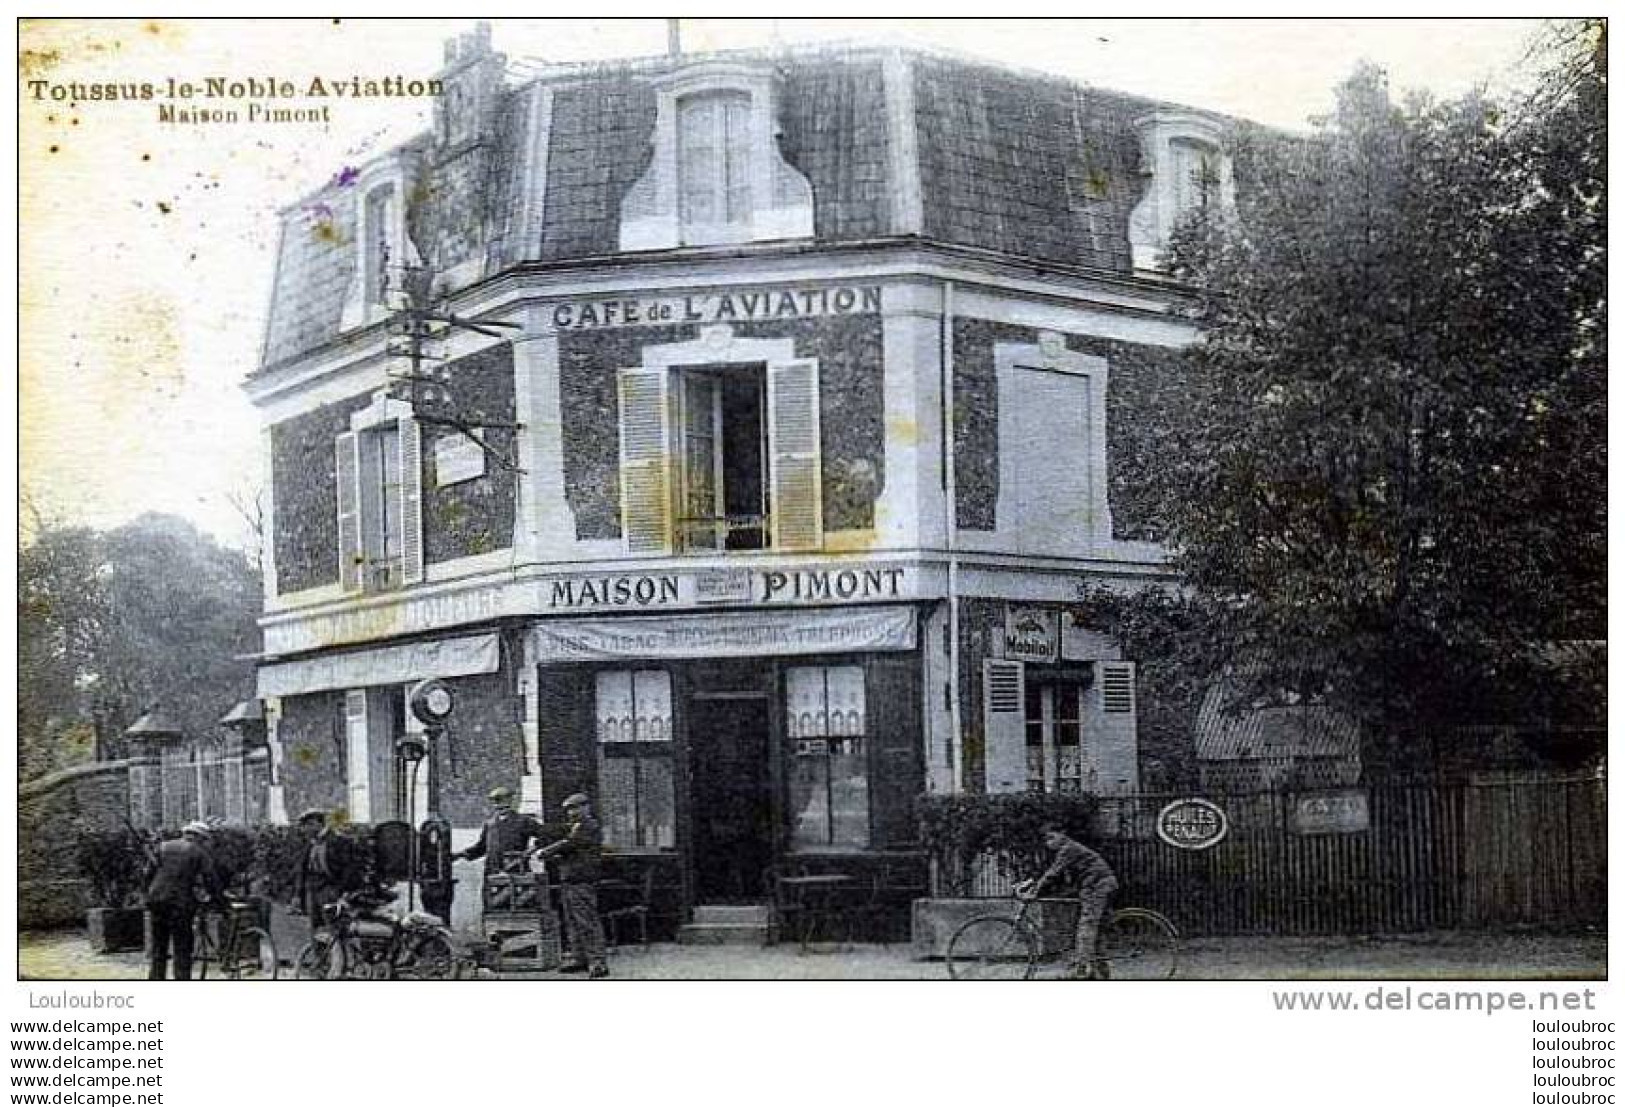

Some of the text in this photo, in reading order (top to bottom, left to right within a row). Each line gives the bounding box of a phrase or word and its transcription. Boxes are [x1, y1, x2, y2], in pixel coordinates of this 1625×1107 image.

[647, 302, 671, 321] de
[550, 576, 680, 607] MAISON
[762, 568, 905, 602] PIMONT
